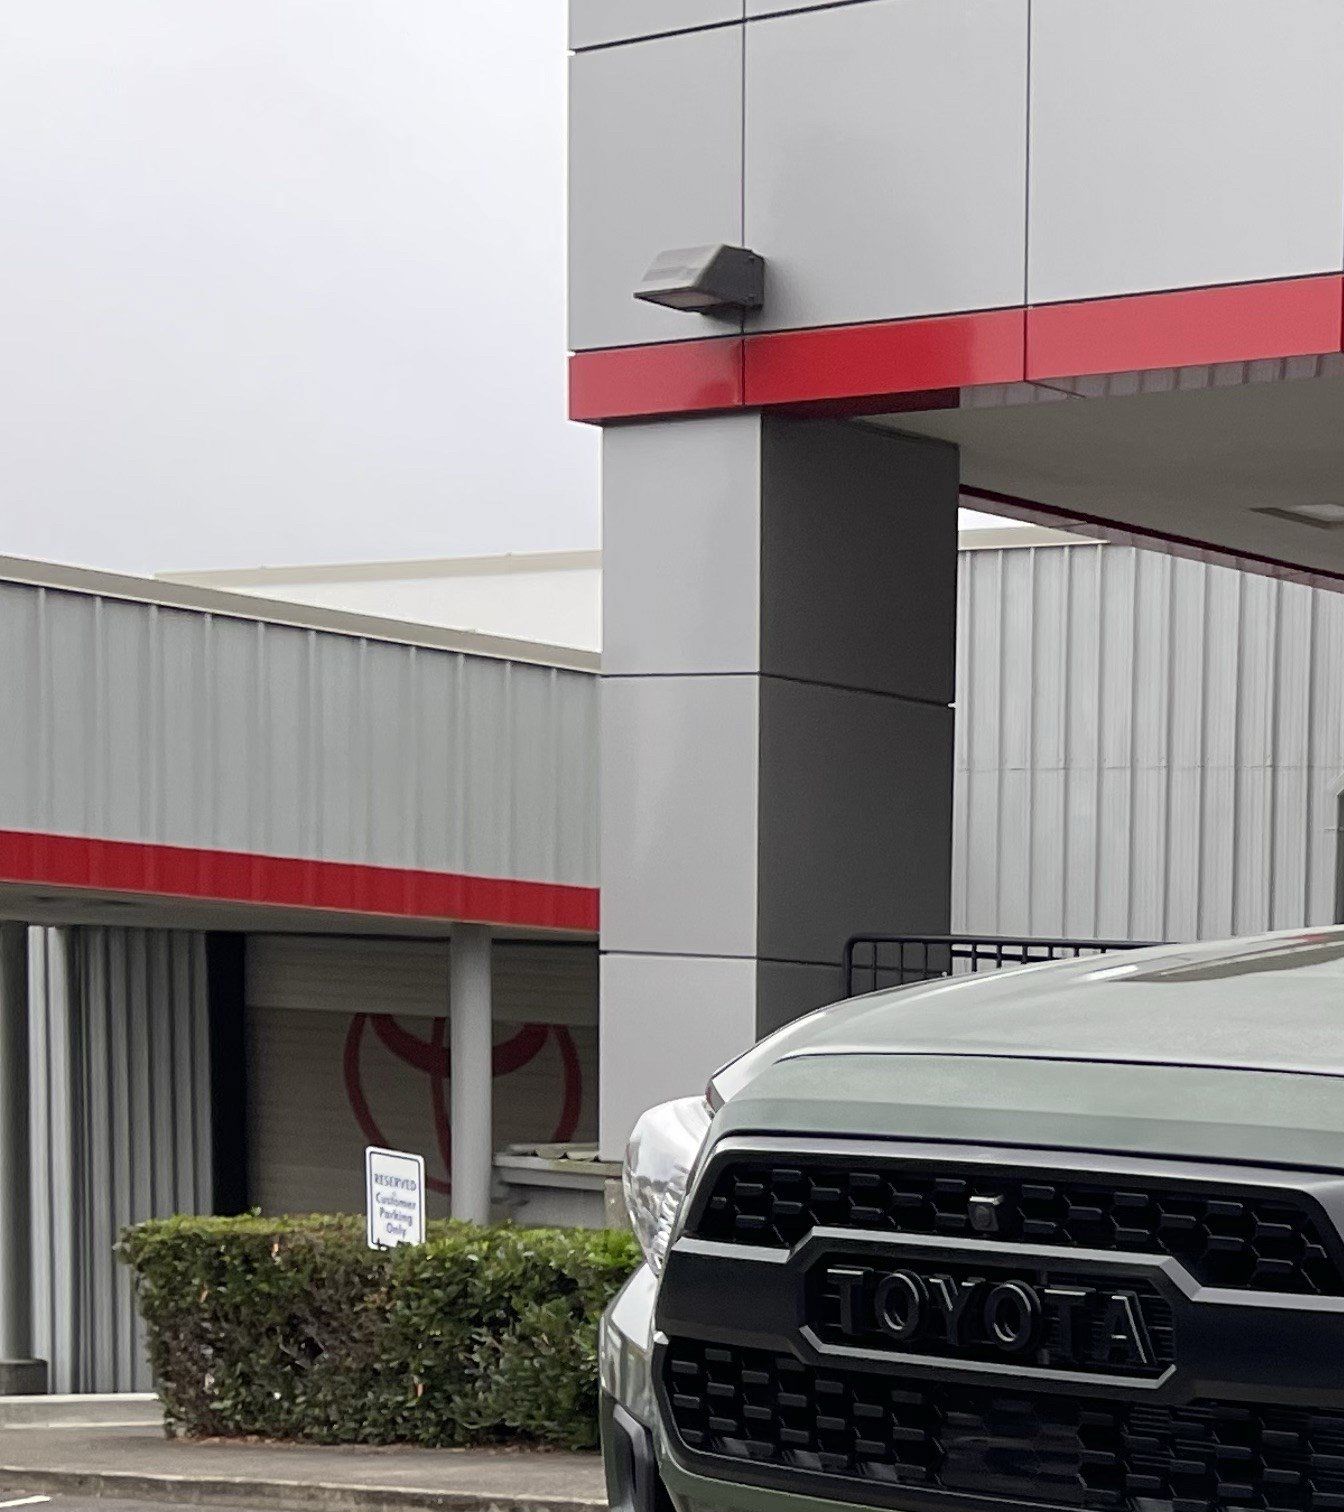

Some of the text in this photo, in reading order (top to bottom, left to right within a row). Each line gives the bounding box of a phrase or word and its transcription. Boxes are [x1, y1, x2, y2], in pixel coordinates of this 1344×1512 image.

[374, 1173, 417, 1192] RESERVED
[376, 1192, 416, 1209] Customer
[380, 1207, 412, 1227] Parking
[386, 1222, 407, 1238] Only
[826, 1264, 1157, 1365] TOYOTA
